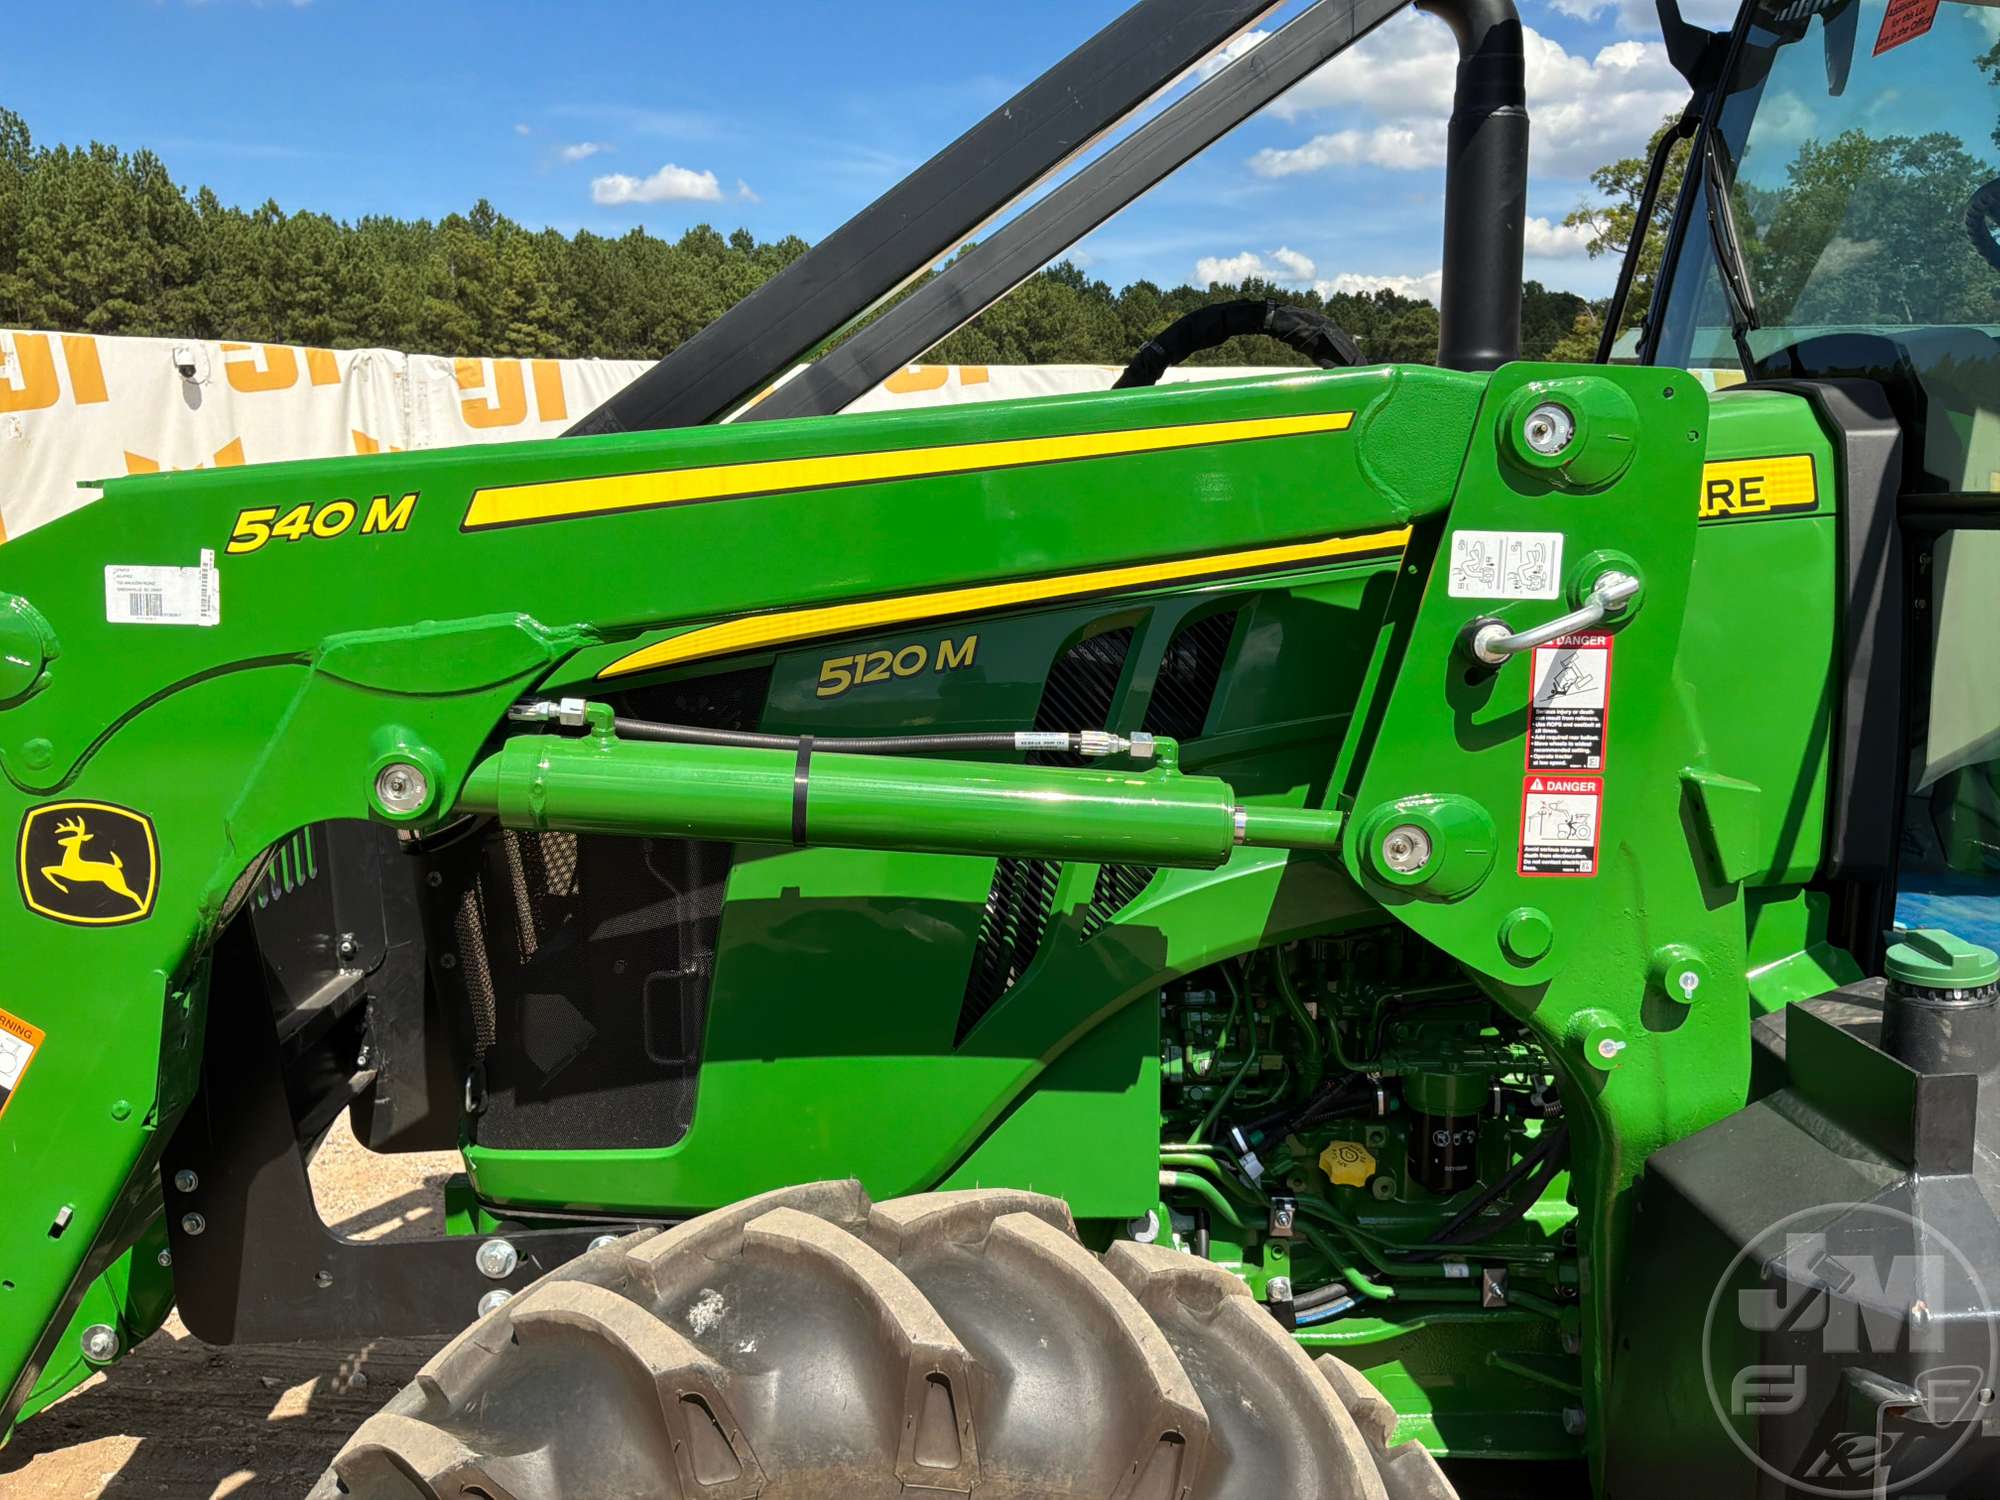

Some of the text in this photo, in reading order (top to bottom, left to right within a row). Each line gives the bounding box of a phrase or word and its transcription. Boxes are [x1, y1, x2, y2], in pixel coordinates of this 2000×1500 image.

[1700, 476, 1766, 510] RE
[224, 491, 421, 555] 540 M
[1556, 635, 1606, 646] DANGER
[816, 635, 978, 698] 5120 M
[1546, 781, 1596, 792] DANGER
